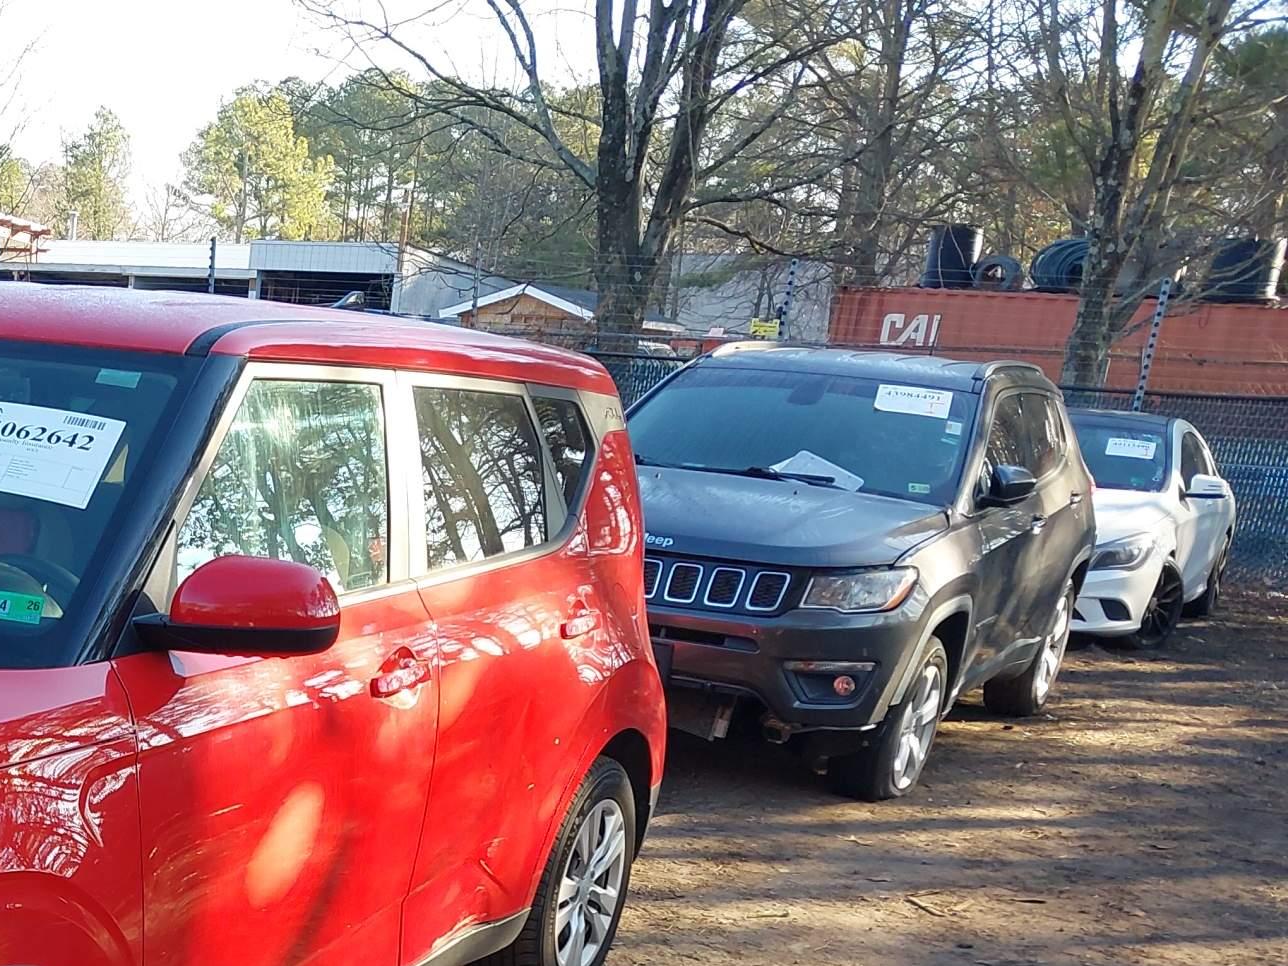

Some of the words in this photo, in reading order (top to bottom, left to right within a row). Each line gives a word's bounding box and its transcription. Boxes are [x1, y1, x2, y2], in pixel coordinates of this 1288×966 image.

[880, 313, 941, 346] CAI
[0, 600, 8, 611] 4
[27, 600, 41, 611] 26
